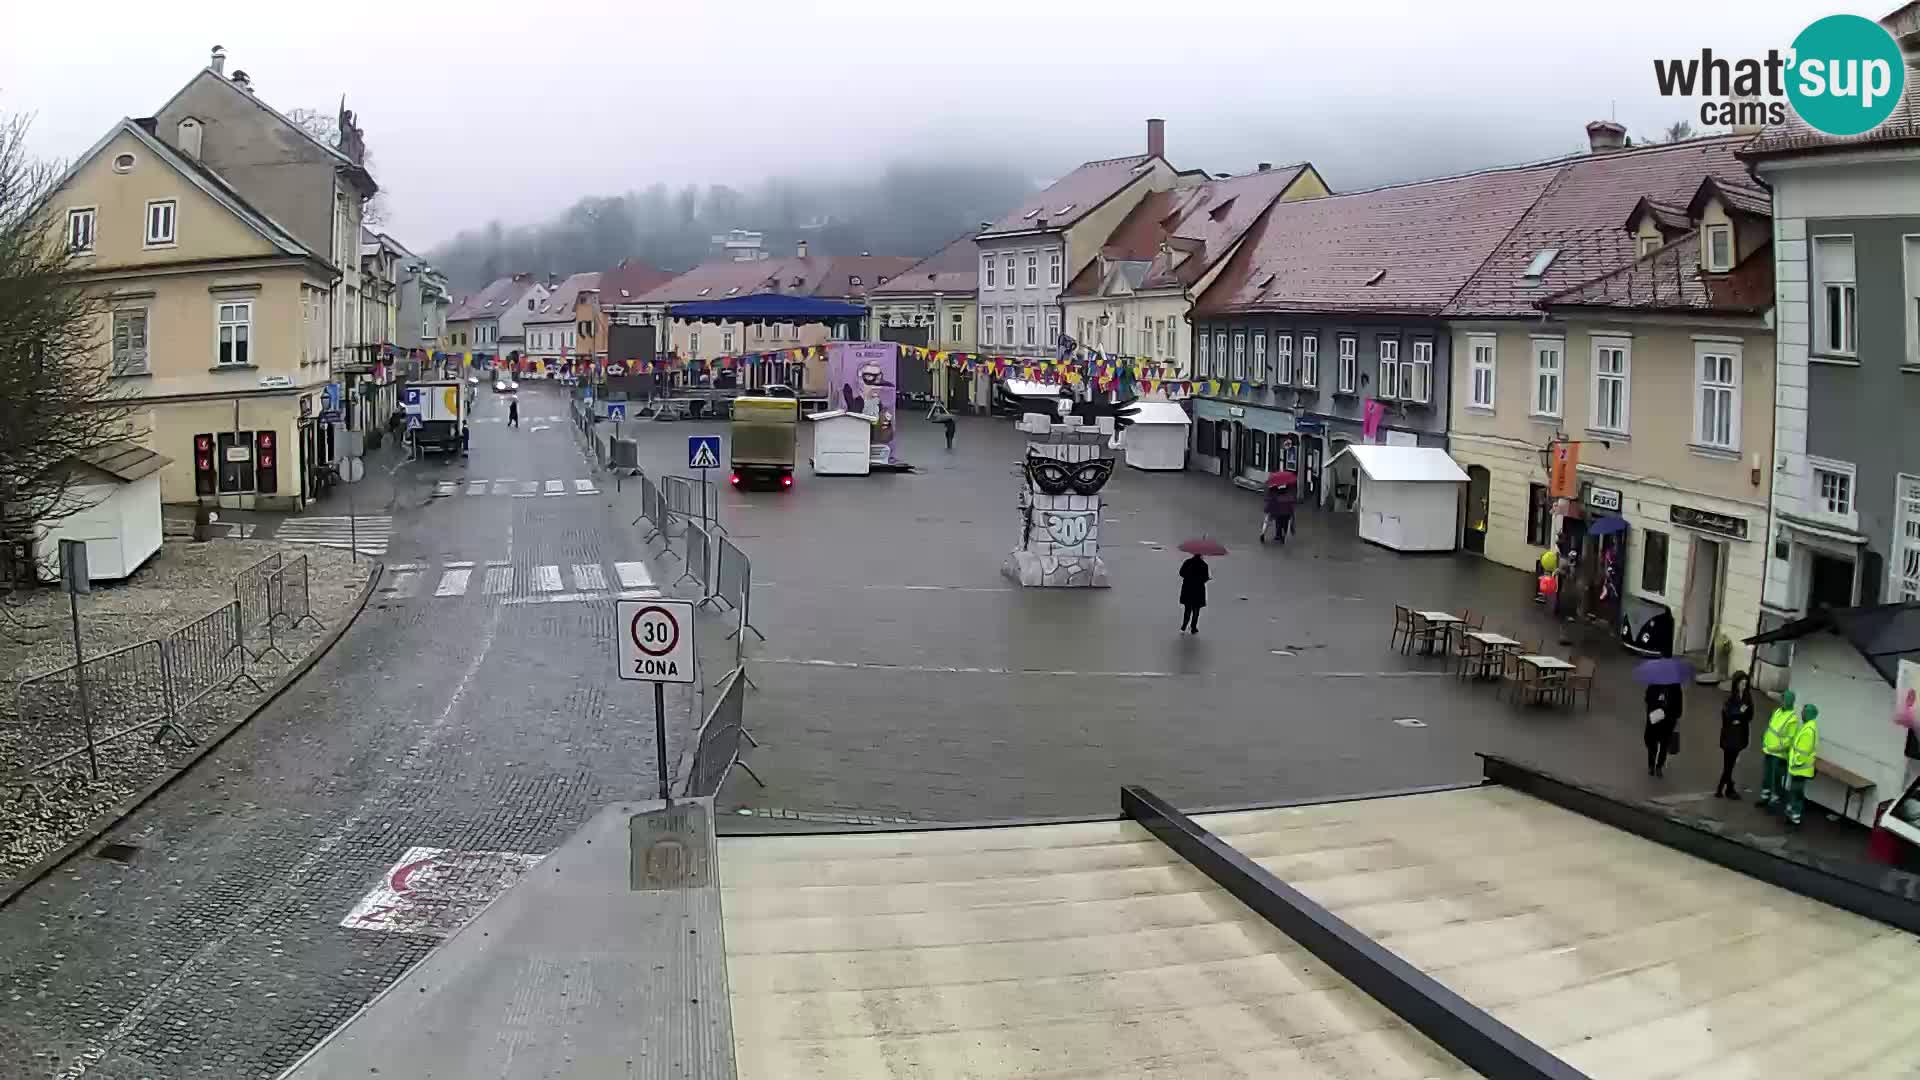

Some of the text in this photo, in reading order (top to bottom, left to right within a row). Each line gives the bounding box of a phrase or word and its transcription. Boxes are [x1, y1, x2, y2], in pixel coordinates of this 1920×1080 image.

[408, 391, 417, 402] P
[1048, 516, 1087, 545] 200
[644, 621, 668, 643] 30
[634, 659, 678, 676] ZONA
